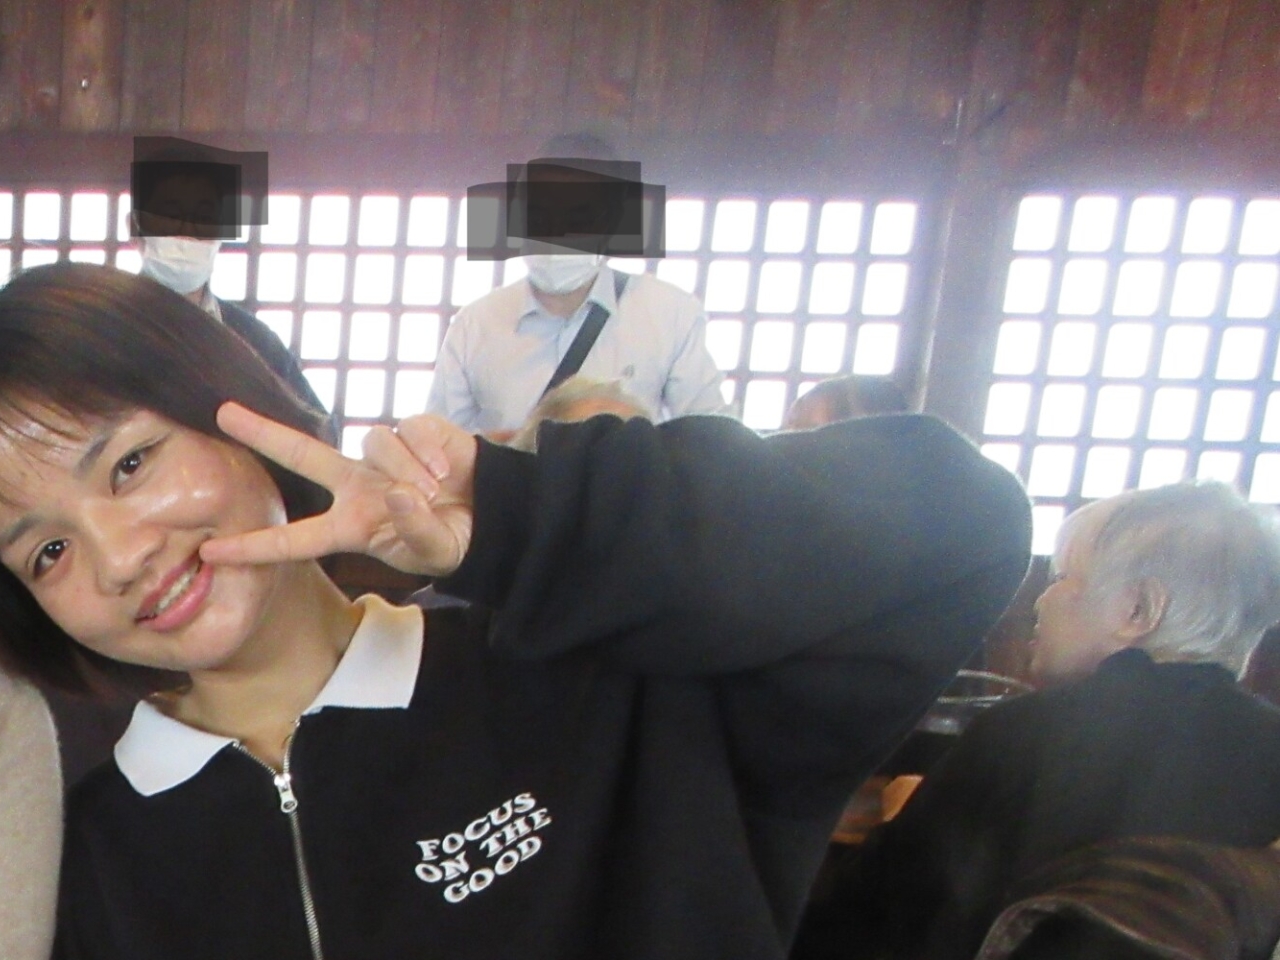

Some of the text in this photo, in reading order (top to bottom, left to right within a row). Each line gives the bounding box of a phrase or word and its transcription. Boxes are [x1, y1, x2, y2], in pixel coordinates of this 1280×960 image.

[415, 808, 552, 883] ON THE
[416, 792, 536, 861] FOCUS
[443, 836, 542, 903] GOOD
